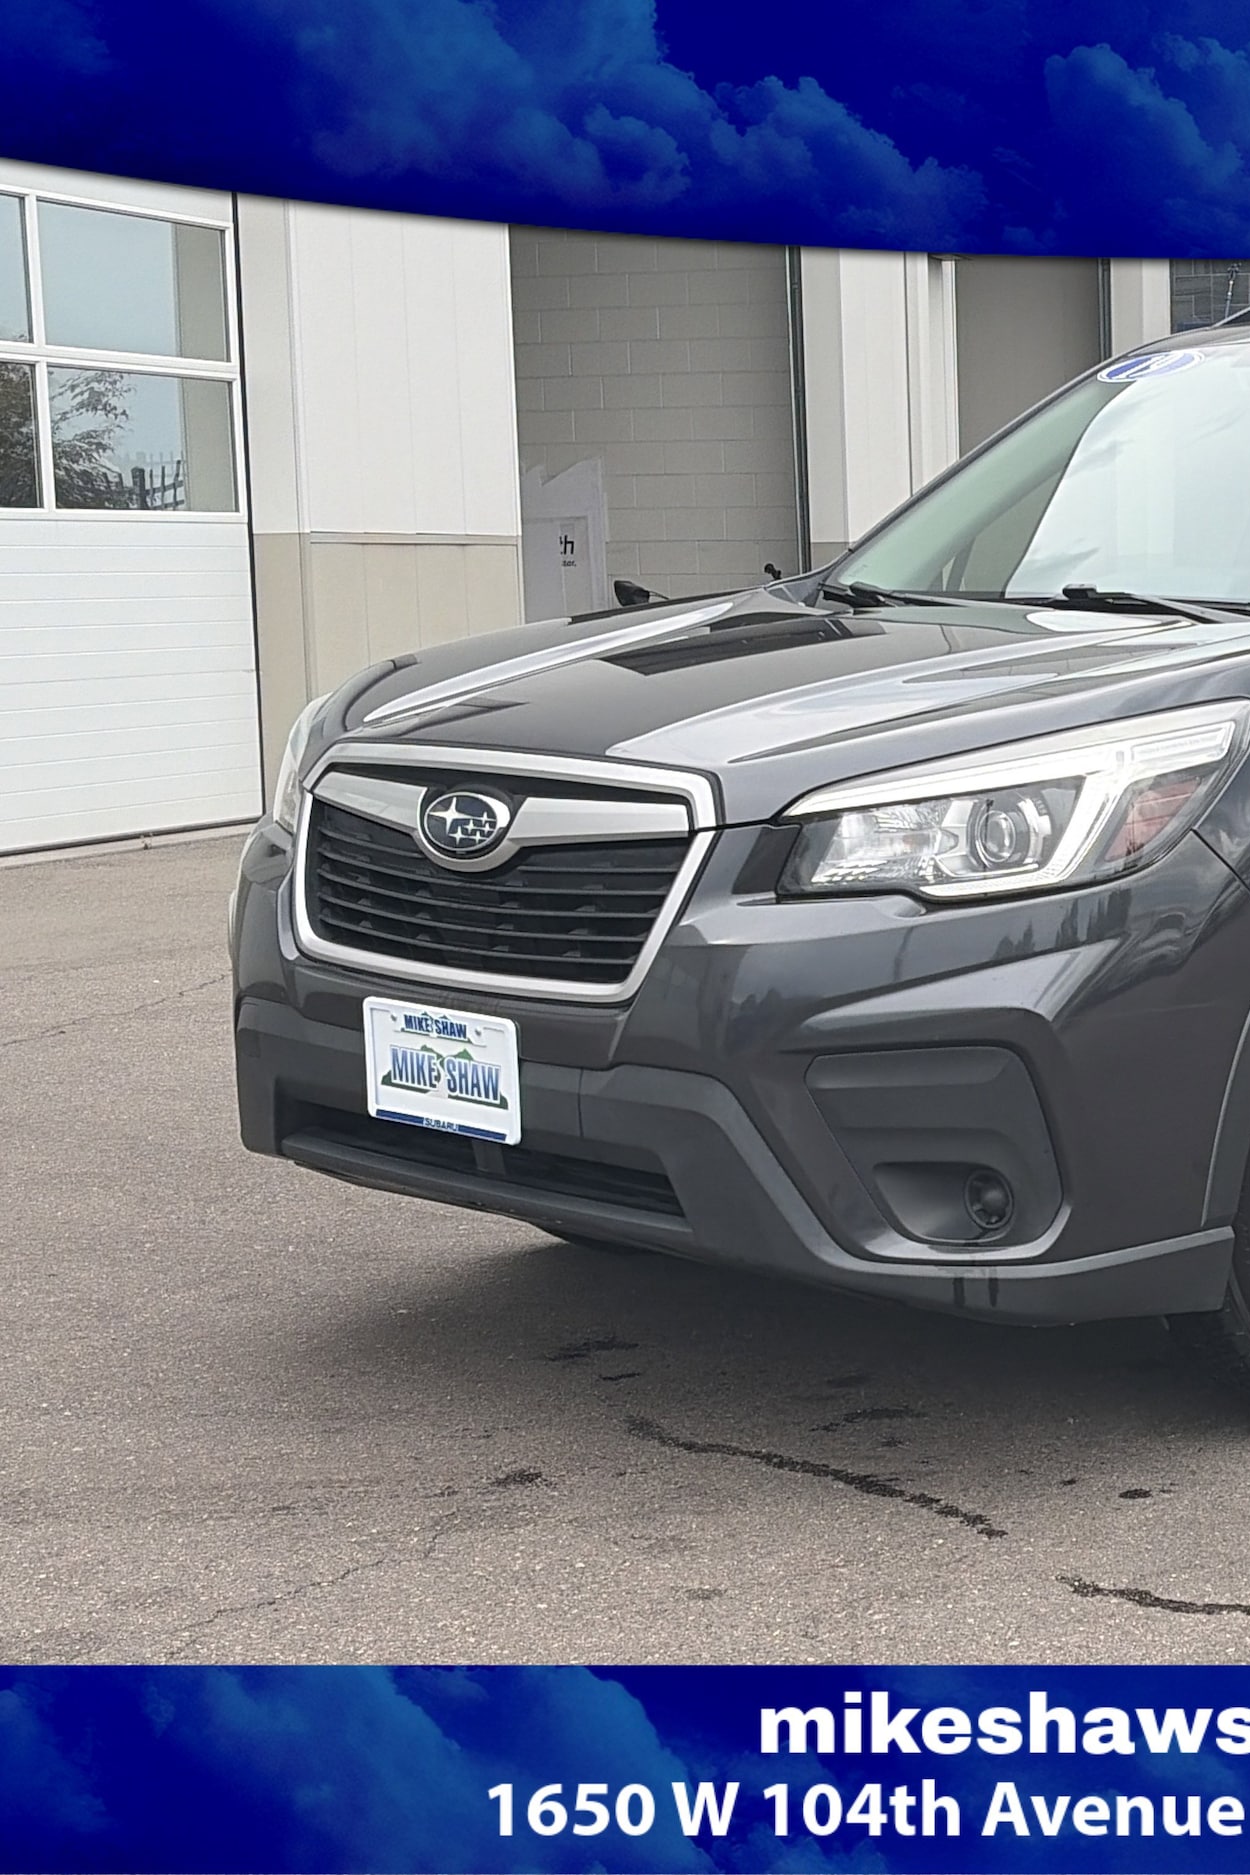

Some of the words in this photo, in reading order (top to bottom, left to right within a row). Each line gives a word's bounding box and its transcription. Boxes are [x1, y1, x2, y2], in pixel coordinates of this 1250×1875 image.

[403, 1013, 432, 1033] MIKE
[434, 1018, 467, 1040] SHAW
[390, 1047, 438, 1089] MIKE
[445, 1056, 501, 1102] SHAW
[424, 1117, 459, 1132] SUBARU
